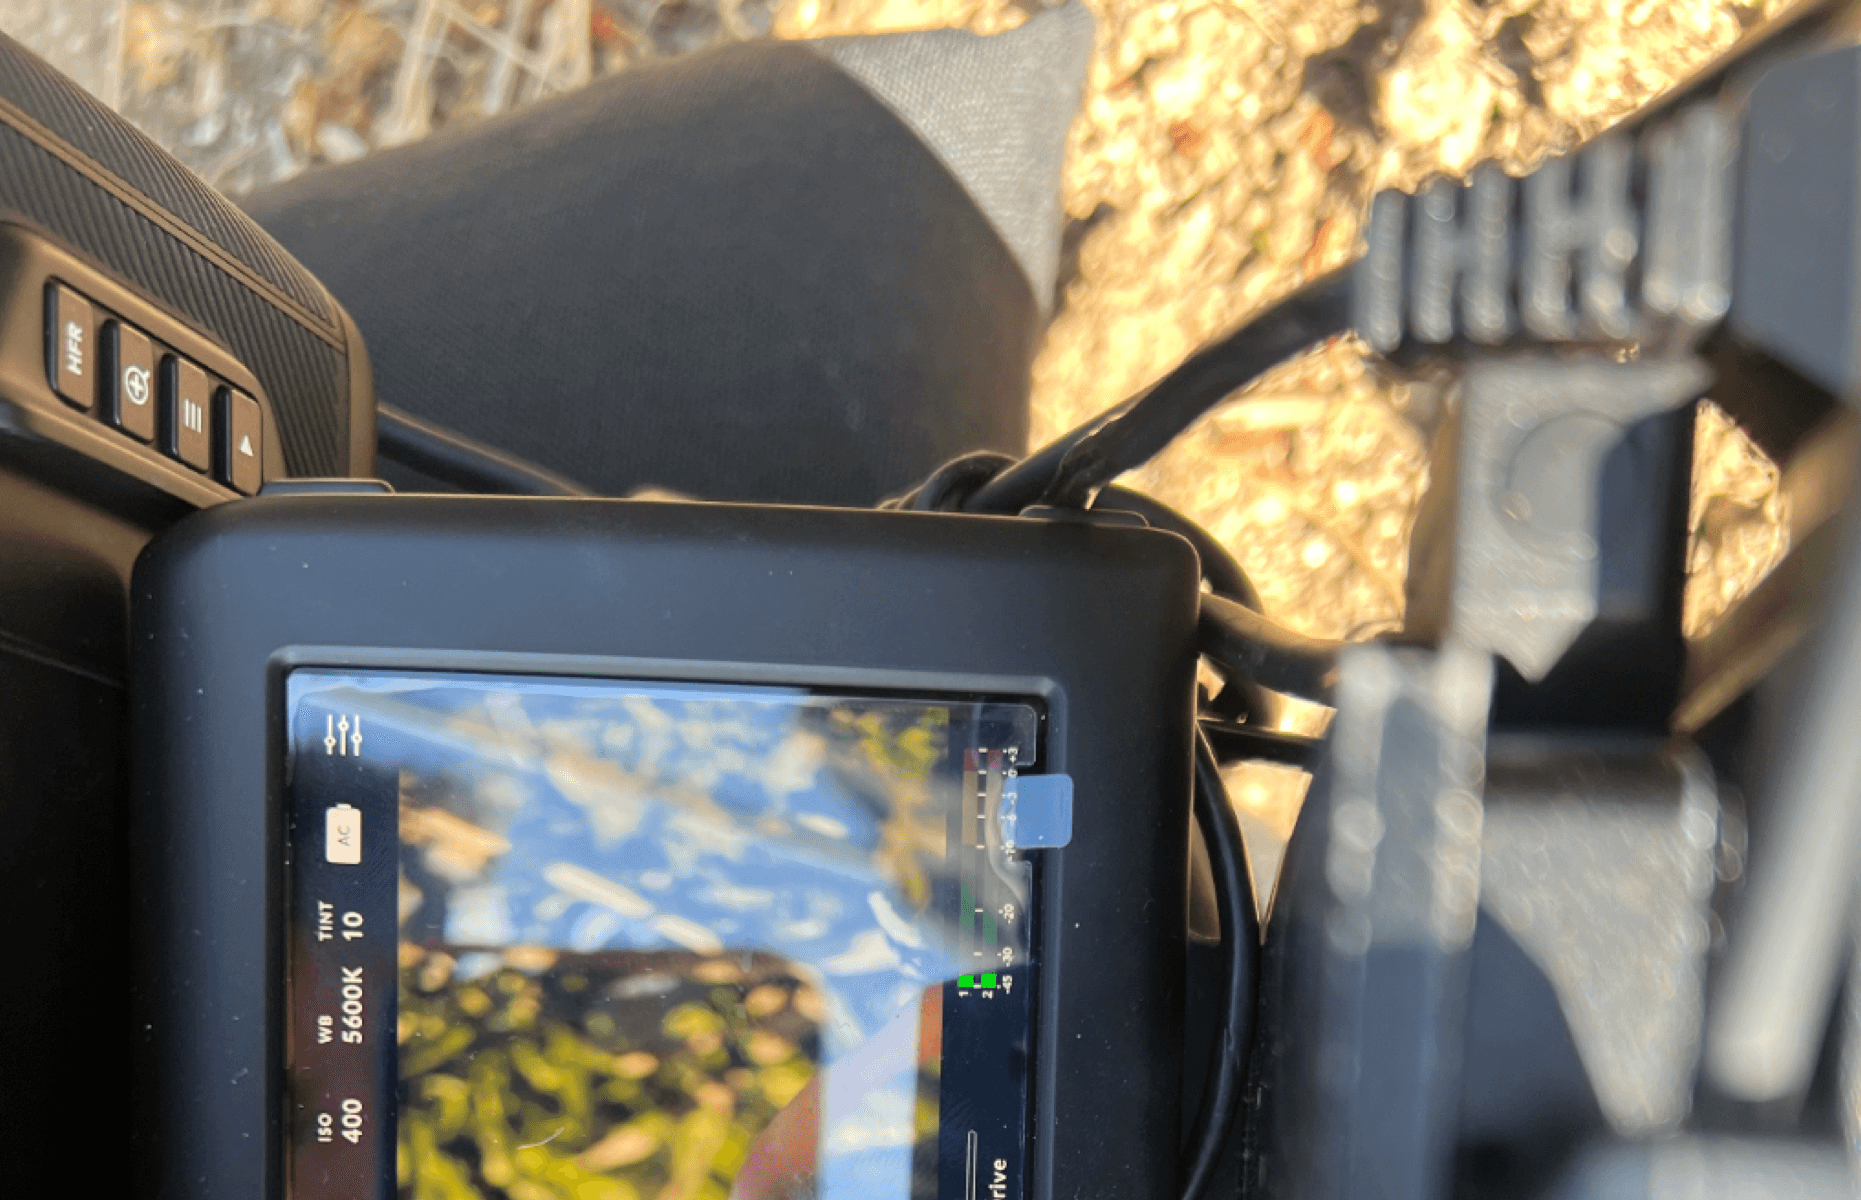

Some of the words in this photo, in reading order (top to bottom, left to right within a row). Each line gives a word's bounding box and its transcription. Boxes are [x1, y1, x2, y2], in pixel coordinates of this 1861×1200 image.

[65, 321, 83, 375] HFR
[337, 824, 351, 847] AC
[318, 901, 334, 941] TINT
[341, 911, 364, 941] 10
[341, 966, 363, 1044] 5600K
[982, 990, 994, 999] 2
[318, 1015, 333, 1044] WB
[318, 1113, 333, 1143] ISO
[341, 1098, 363, 1144] 400
